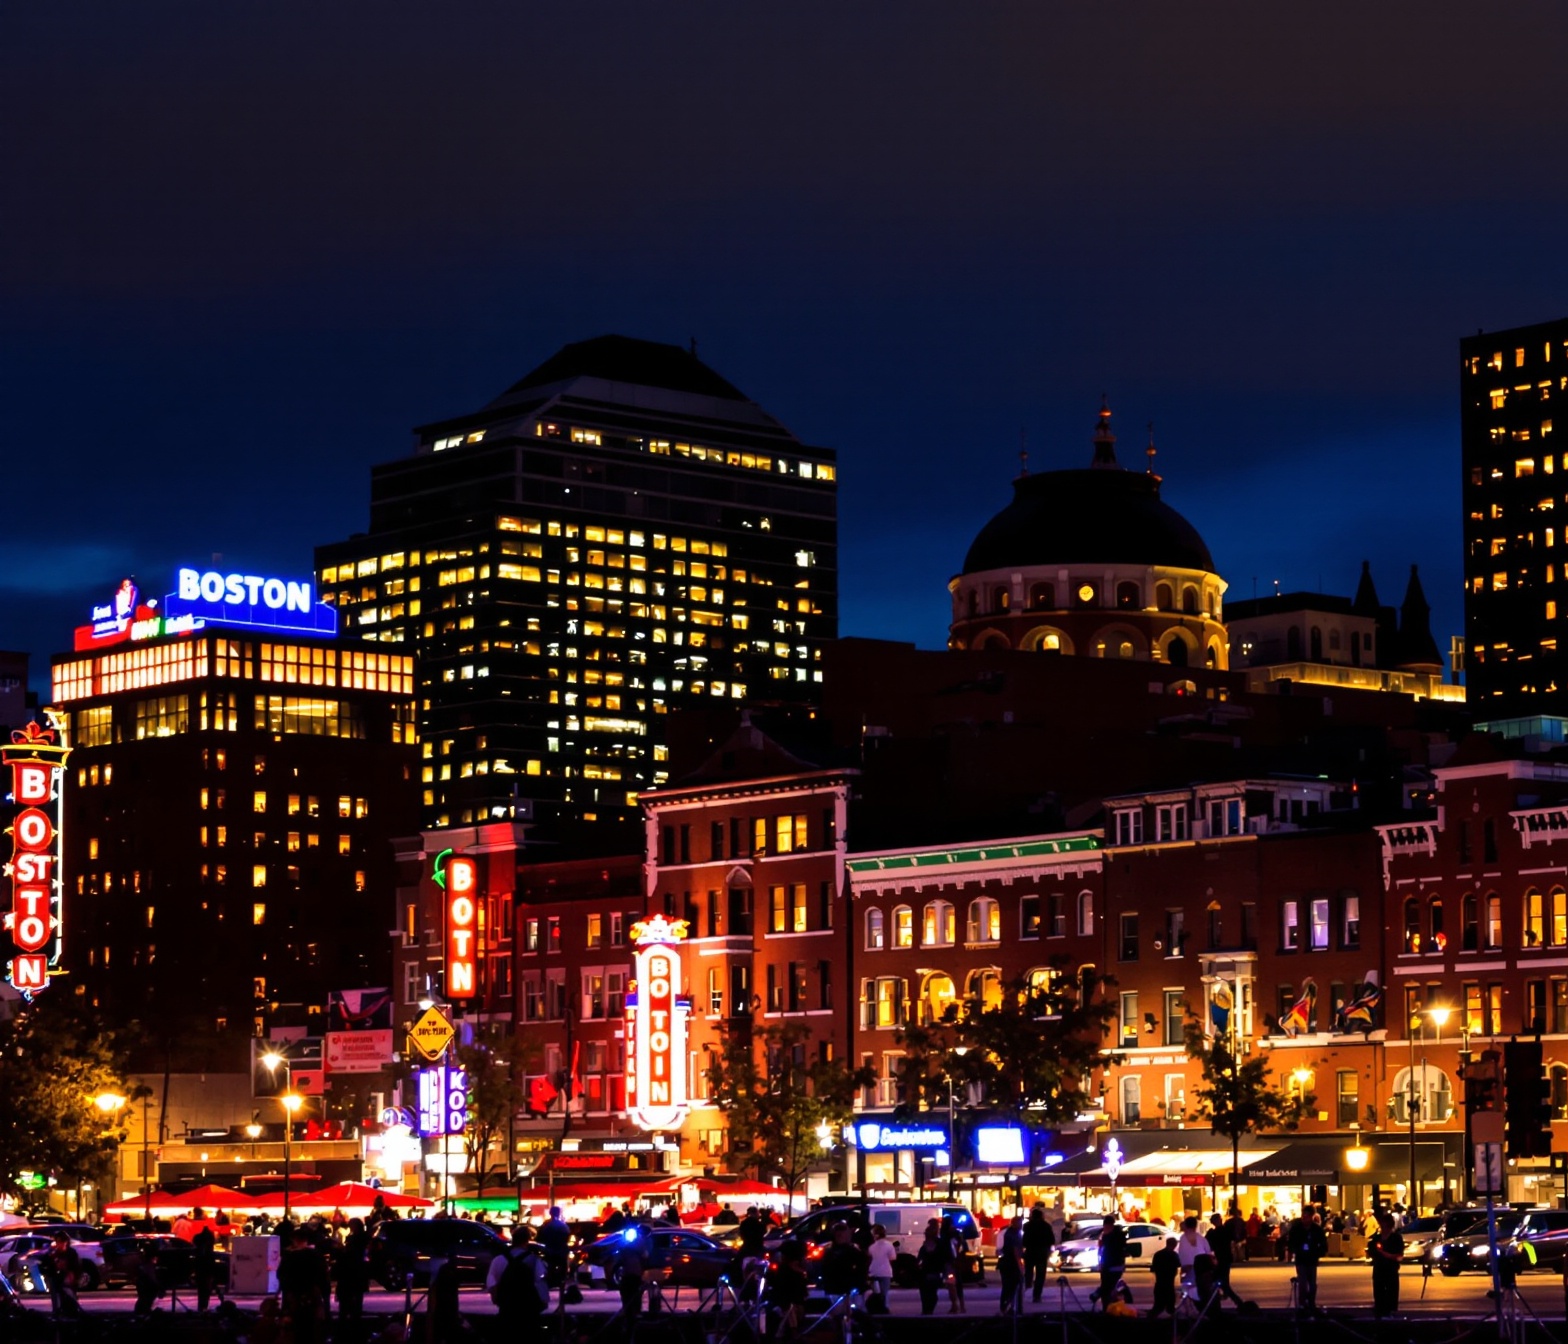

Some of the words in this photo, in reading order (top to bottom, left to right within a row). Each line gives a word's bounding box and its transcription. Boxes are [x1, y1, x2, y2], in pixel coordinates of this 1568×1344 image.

[178, 568, 311, 613] BOSTON
[17, 768, 51, 984] BOSTON
[452, 863, 473, 991] BOTN
